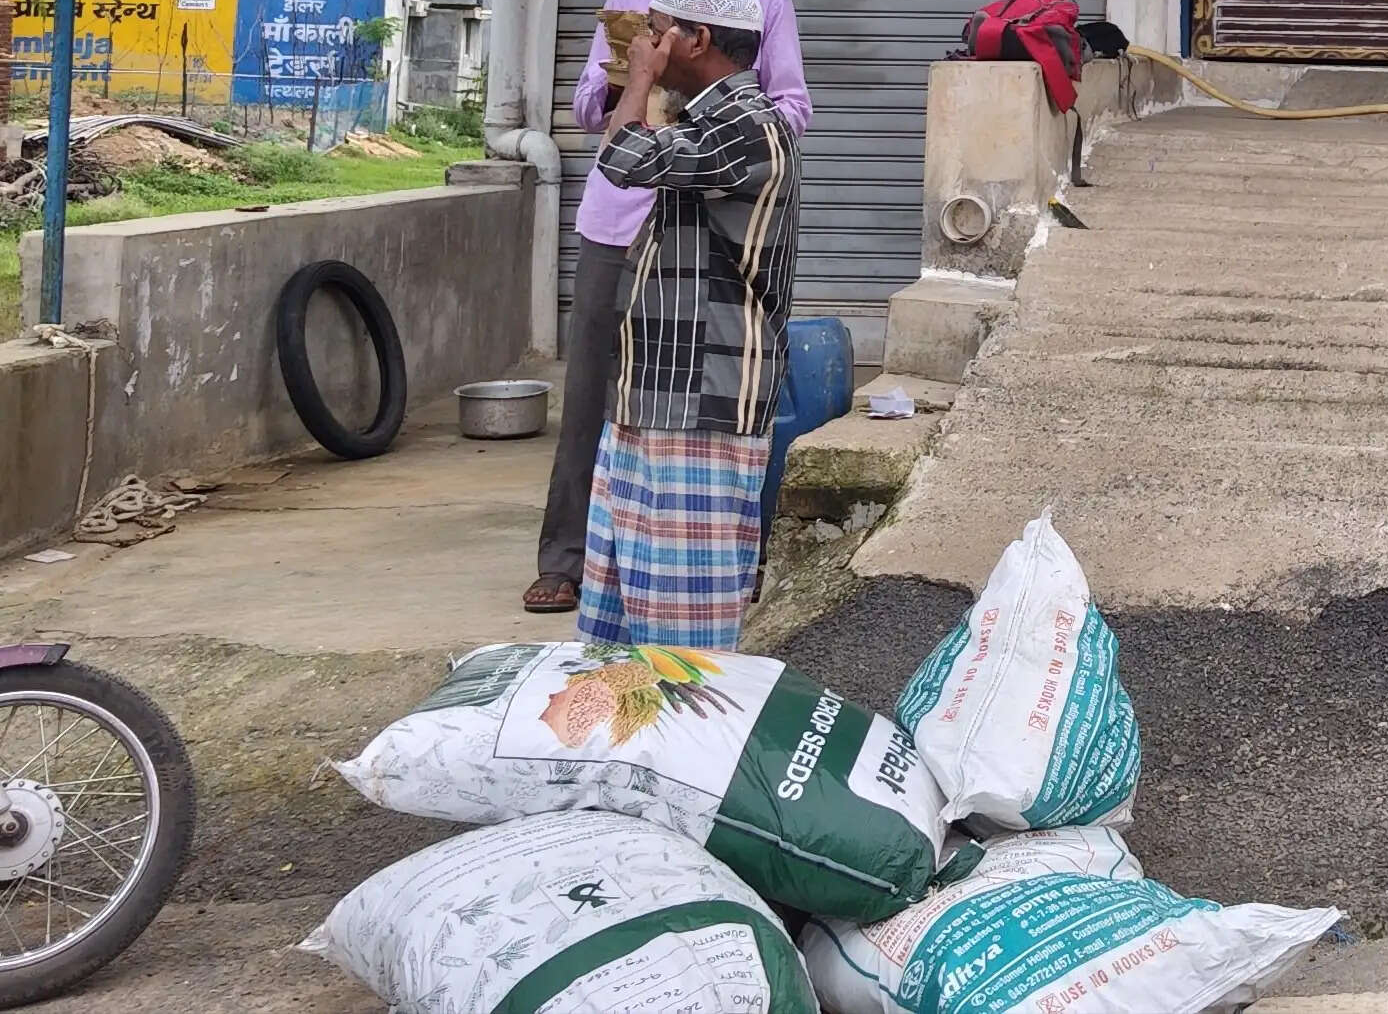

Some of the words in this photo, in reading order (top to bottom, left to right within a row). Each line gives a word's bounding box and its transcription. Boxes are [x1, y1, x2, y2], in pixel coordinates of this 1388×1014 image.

[293, 16, 355, 47] काली
[1053, 632, 1068, 654] USE
[1048, 659, 1064, 675] NO
[1036, 679, 1059, 713] HOOKS
[810, 696, 843, 734] CROP
[778, 731, 827, 801] SEEDS
[1012, 889, 1062, 919] ADITYA
[706, 948, 753, 964] PCKING
[1026, 941, 1065, 968] Helpline
[1059, 981, 1088, 1005] USE
[1089, 969, 1110, 989] NO
[1111, 943, 1156, 976] HOOKS
